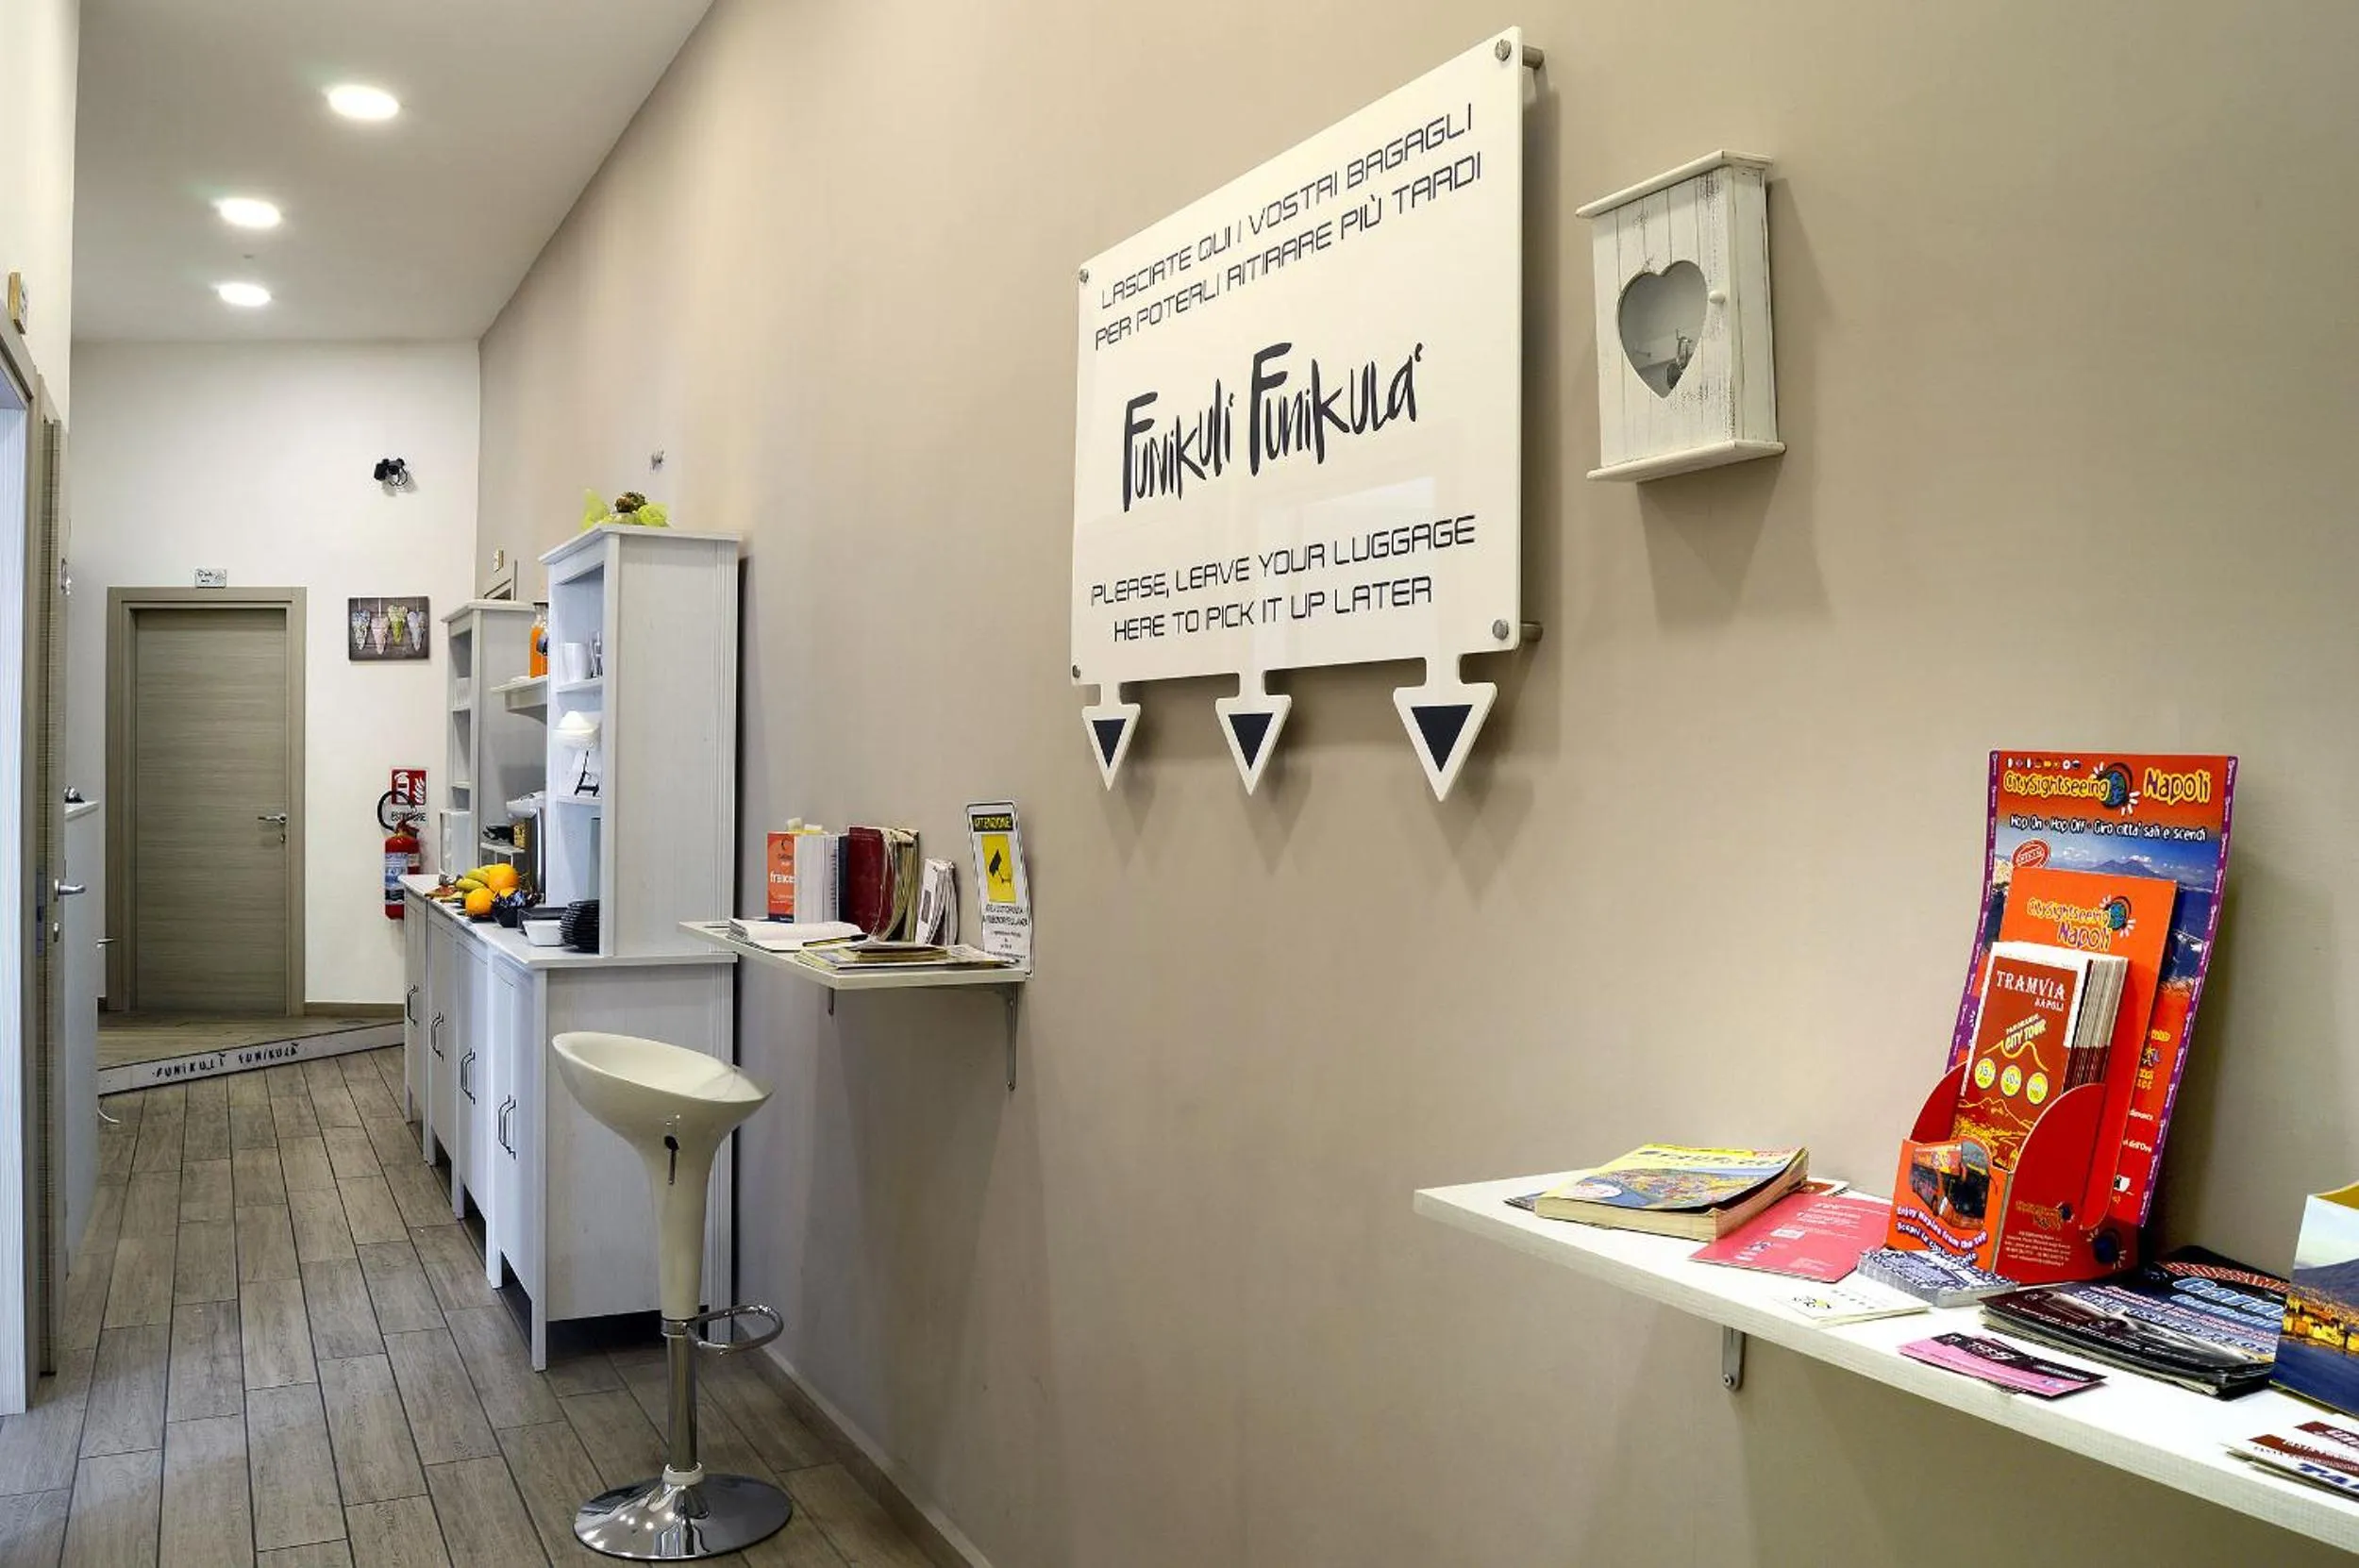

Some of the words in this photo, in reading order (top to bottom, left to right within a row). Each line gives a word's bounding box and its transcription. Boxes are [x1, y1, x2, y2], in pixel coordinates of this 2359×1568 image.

[1102, 245, 1192, 309] LASCIATE
[1198, 225, 1230, 261] QUI
[1237, 220, 1242, 243] I
[1248, 171, 1338, 235] VOSTRI
[1347, 103, 1472, 190] BAGAGLI
[1096, 316, 1131, 350] PER
[1136, 272, 1220, 332] POTERLI
[1227, 222, 1332, 291] RITIRARE
[1341, 194, 1381, 240] PIÙ
[1392, 151, 1481, 214] TARDI
[1092, 573, 1169, 606] PLEASE,
[1176, 557, 1249, 592] LEAVE
[1259, 542, 1325, 577] YOUR
[1333, 514, 1475, 565] LUGGAGE
[1113, 613, 1164, 642] HERE
[1172, 609, 1199, 634] TO
[1206, 599, 1255, 630] PICK
[1262, 596, 1282, 624] IT
[1291, 591, 1325, 620] UP
[1333, 575, 1432, 615] LATER
[2143, 767, 2211, 806] Napoli
[2173, 826, 2207, 842] scendi
[1996, 970, 2066, 1001] TRAMVIA
